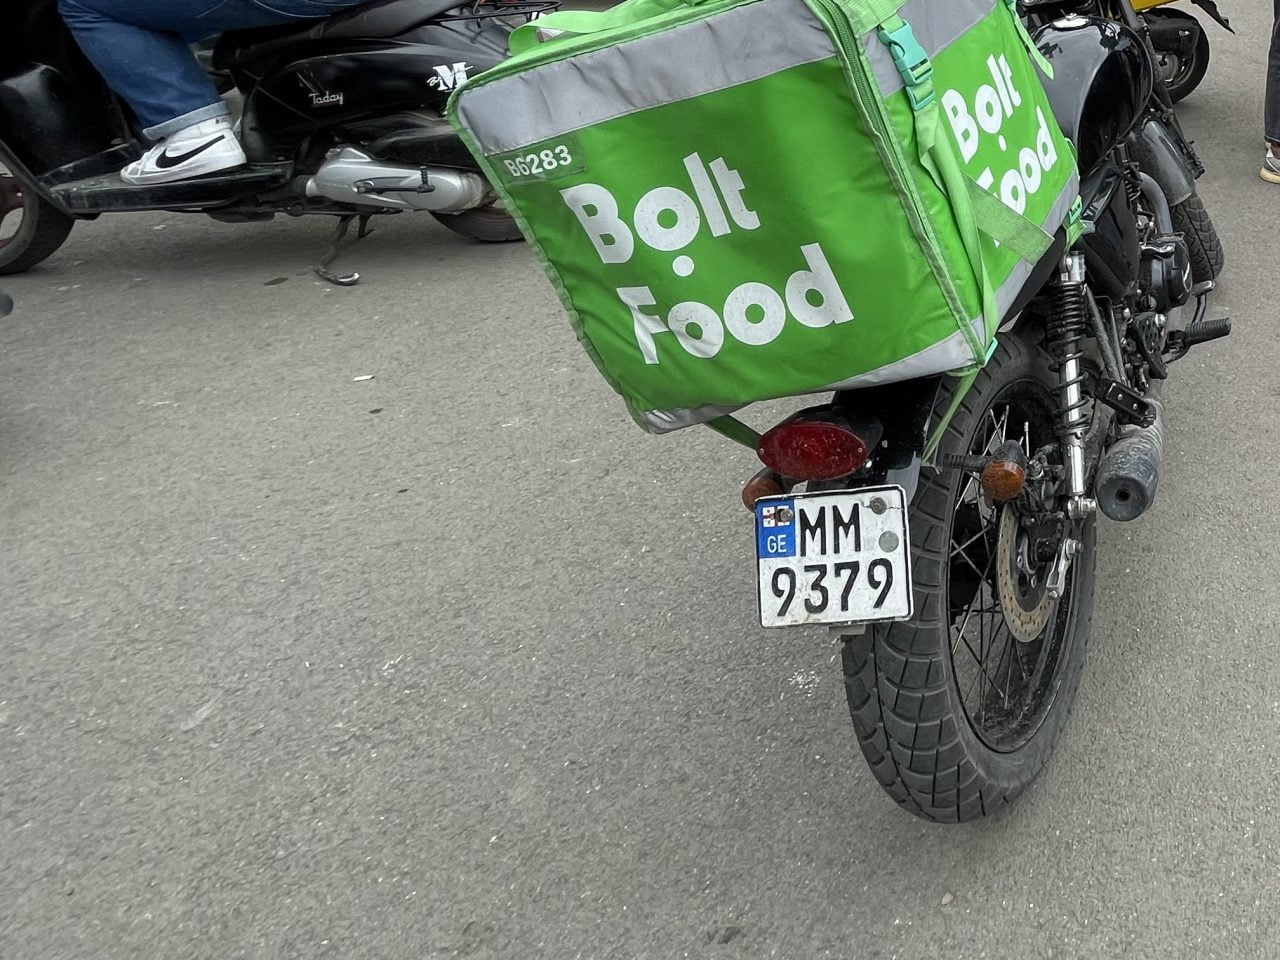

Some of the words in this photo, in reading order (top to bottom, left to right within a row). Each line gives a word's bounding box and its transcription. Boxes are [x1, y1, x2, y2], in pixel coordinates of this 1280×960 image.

[308, 90, 344, 105] Today
[941, 52, 1022, 164] Bolt
[503, 145, 572, 177] B6283
[559, 151, 761, 264] Bolt
[616, 242, 854, 365] Food
[767, 534, 787, 553] GE
[799, 502, 862, 557] MM
[771, 557, 893, 617] 9379
